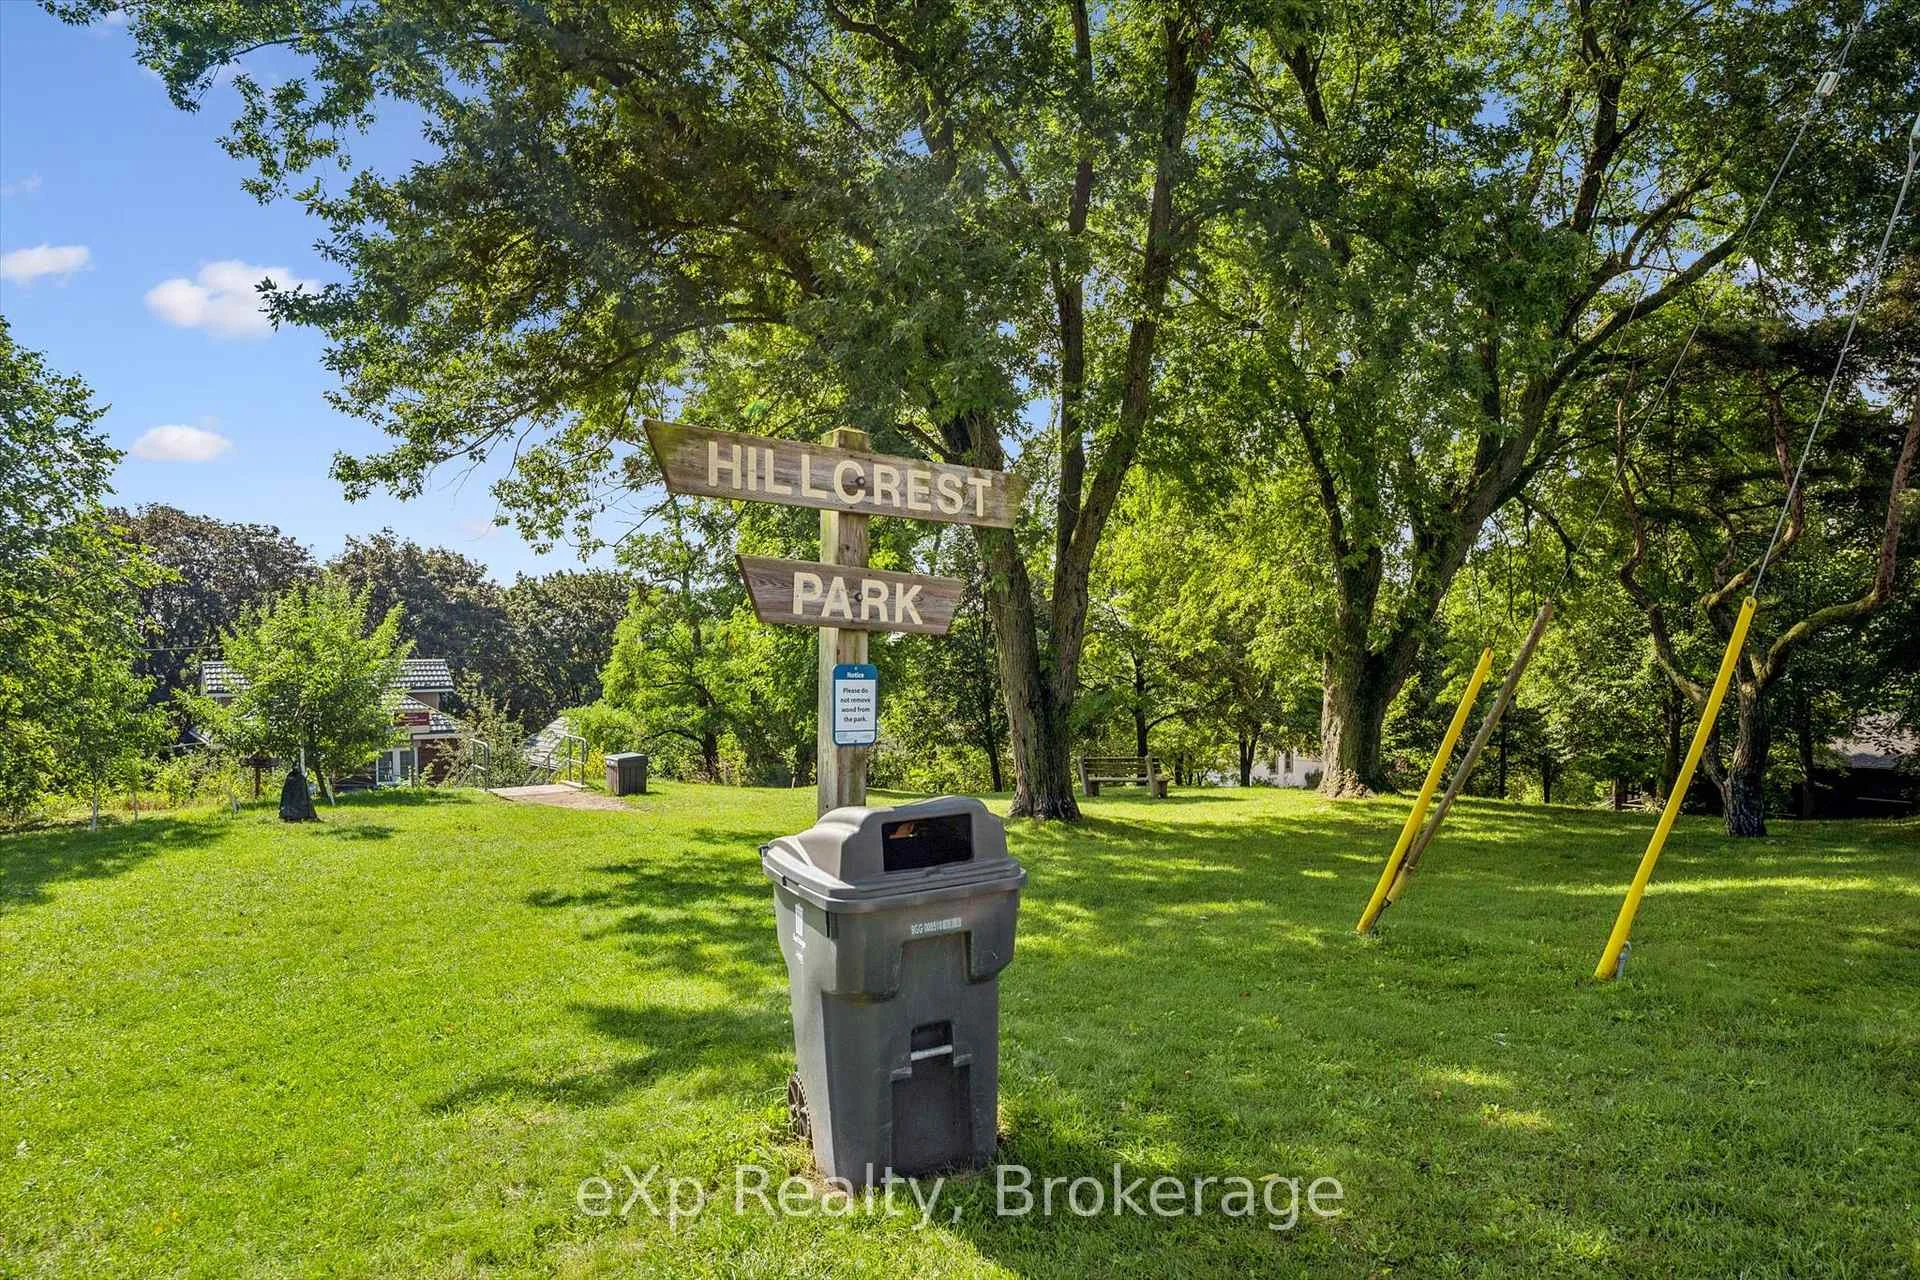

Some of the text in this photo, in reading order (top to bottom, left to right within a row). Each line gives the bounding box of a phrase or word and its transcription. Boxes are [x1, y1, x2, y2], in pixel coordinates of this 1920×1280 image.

[708, 441, 992, 517] HILLCREST
[792, 572, 924, 625] PARK
[847, 671, 864, 679] Notice
